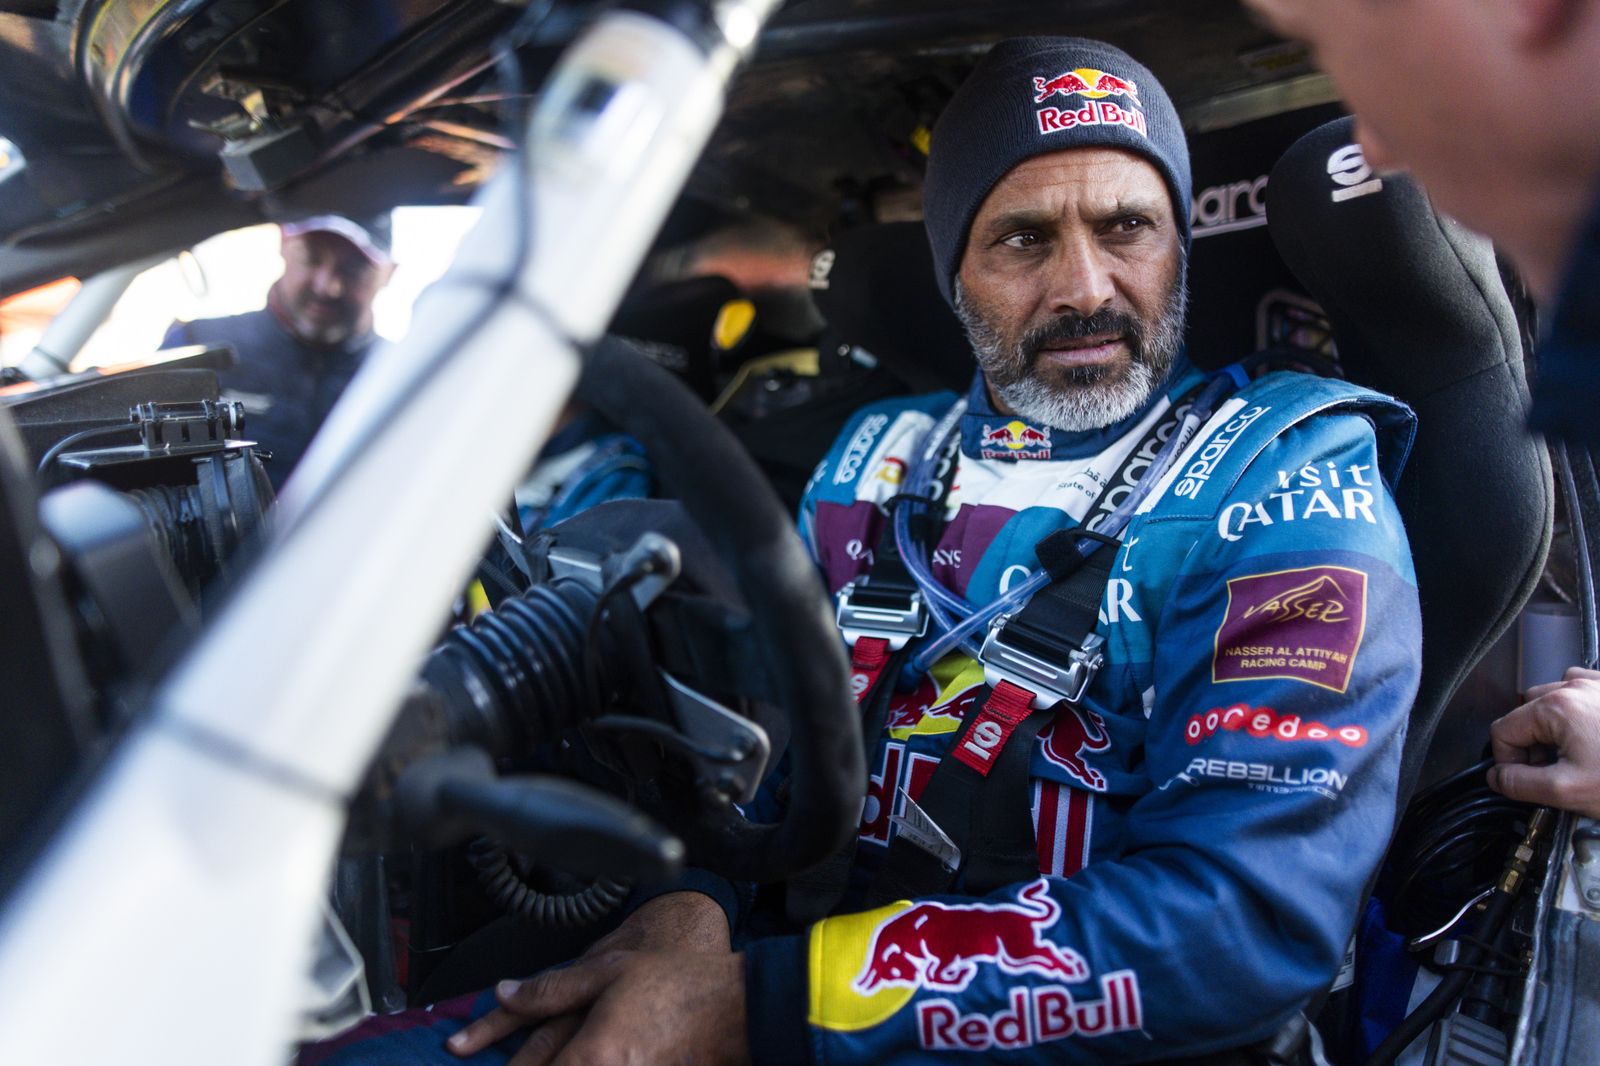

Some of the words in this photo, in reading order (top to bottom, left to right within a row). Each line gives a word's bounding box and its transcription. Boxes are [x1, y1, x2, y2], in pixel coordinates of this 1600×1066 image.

[1038, 101, 1098, 133] Red
[1101, 102, 1146, 136] Bull
[1175, 406, 1268, 499] sparco
[1218, 488, 1377, 542] QATAR
[1225, 646, 1273, 657] NASSER
[1276, 647, 1293, 656] AL
[1240, 658, 1286, 669] RACING
[1288, 658, 1327, 672] CAMP
[1187, 706, 1362, 743] ooredoo
[1186, 757, 1348, 791] REBELLION
[918, 988, 1031, 1049] Red
[1034, 974, 1141, 1041] Bull
